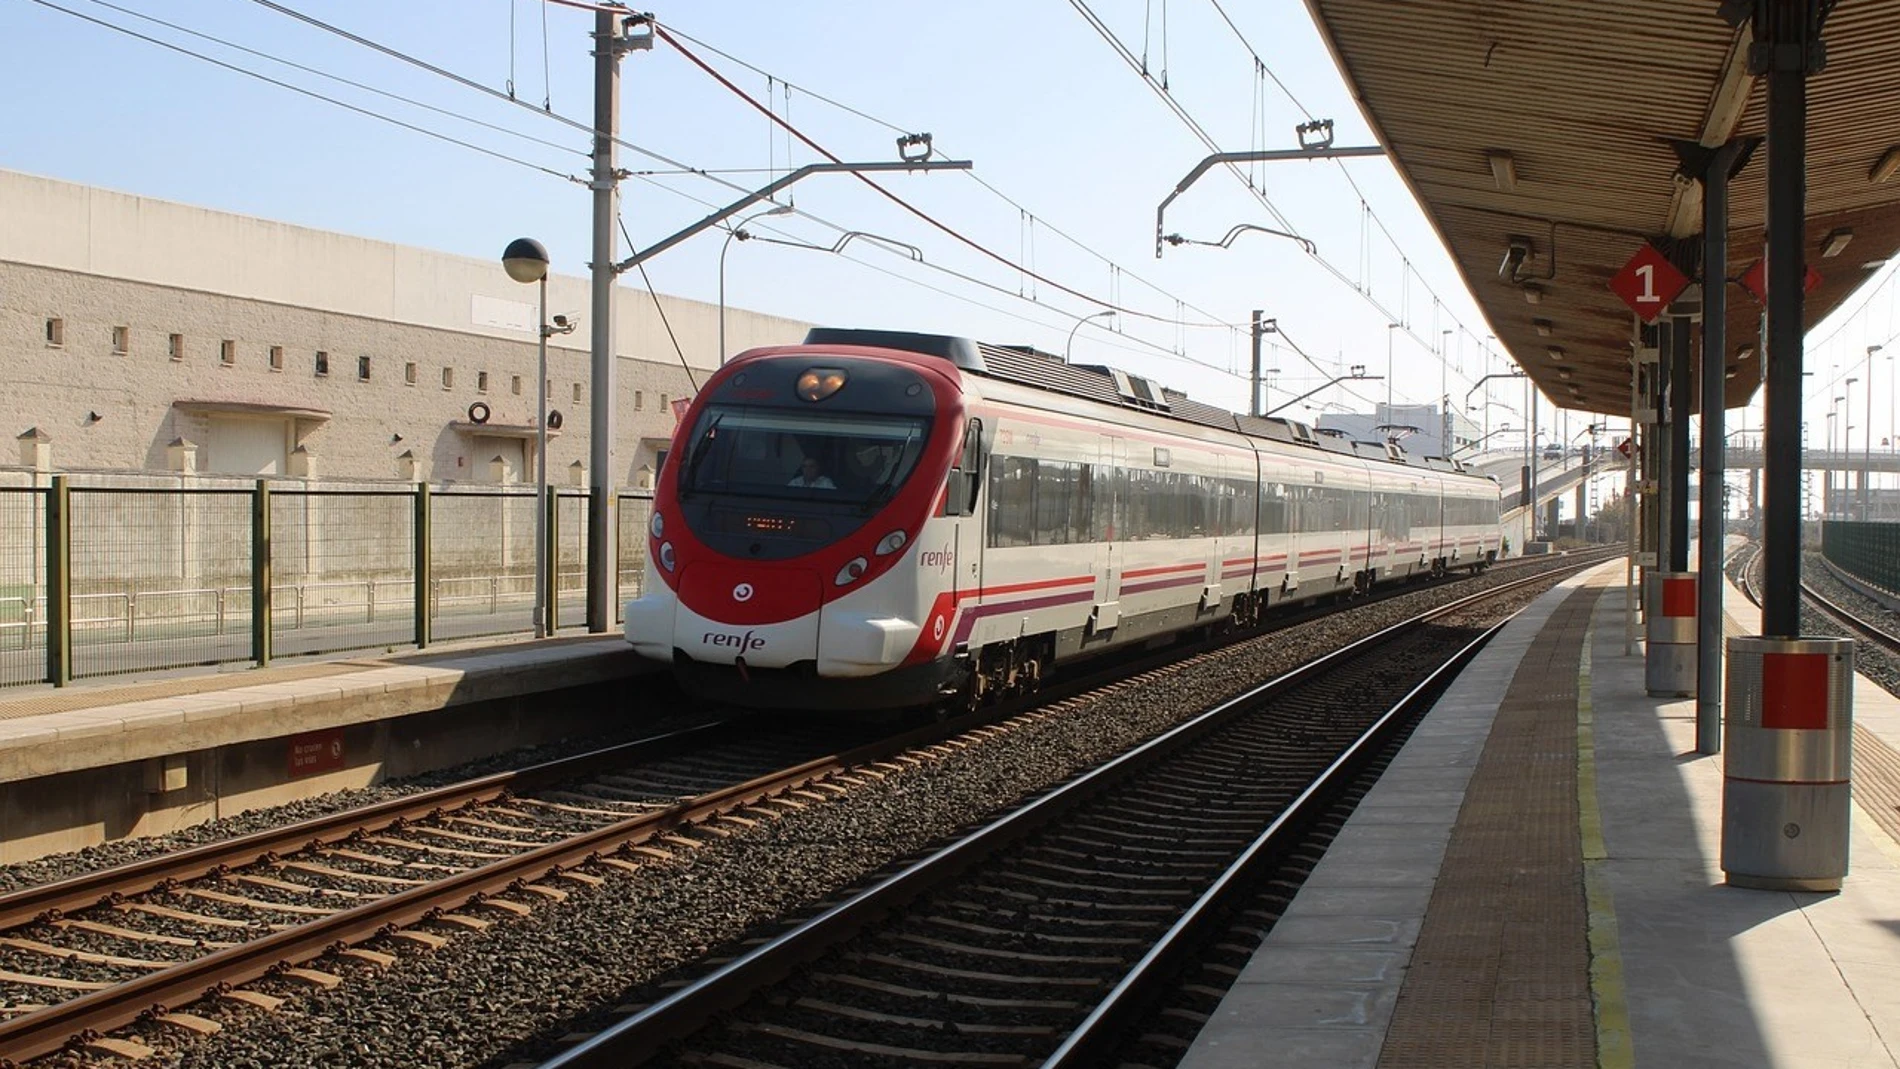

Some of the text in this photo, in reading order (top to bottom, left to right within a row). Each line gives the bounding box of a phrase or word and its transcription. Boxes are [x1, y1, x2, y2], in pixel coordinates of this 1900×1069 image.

[1635, 264, 1660, 302] 1
[920, 542, 953, 576] renfe
[703, 630, 765, 654] renfe
